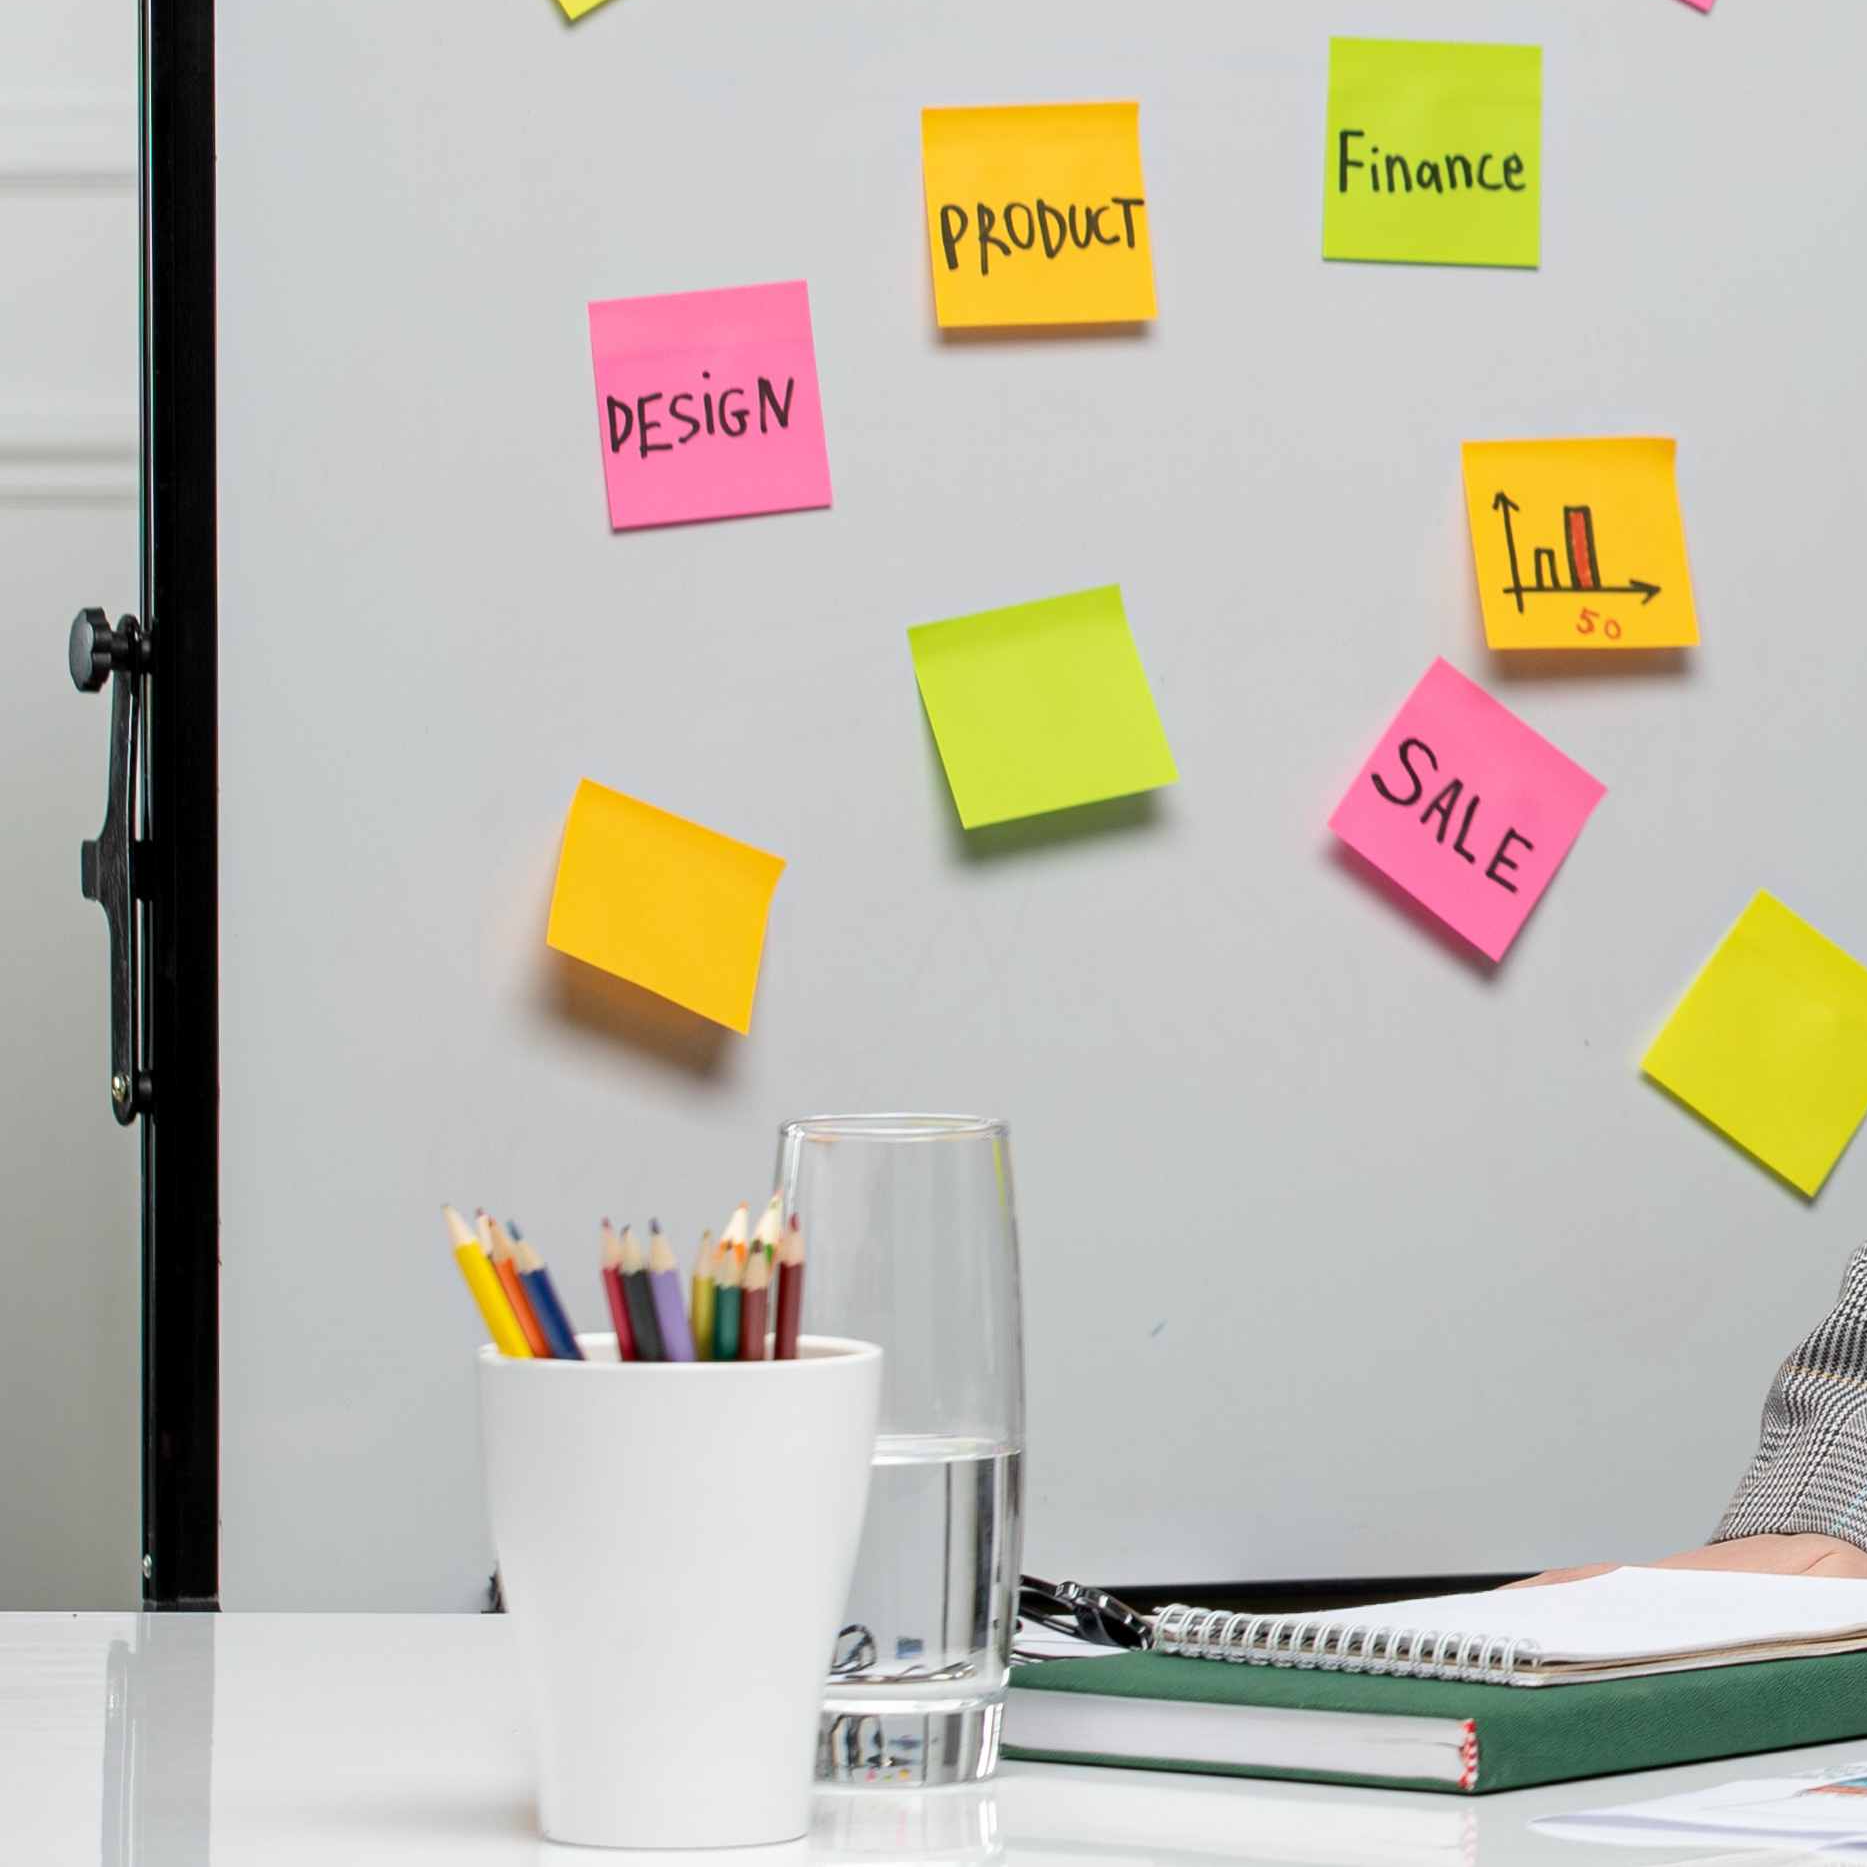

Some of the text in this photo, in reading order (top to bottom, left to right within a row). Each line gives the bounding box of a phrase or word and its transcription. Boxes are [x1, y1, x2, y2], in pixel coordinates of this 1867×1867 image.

[1338, 128, 1527, 196] Finance
[939, 196, 1146, 277] PRODUCT
[1370, 737, 1535, 895] SALE
